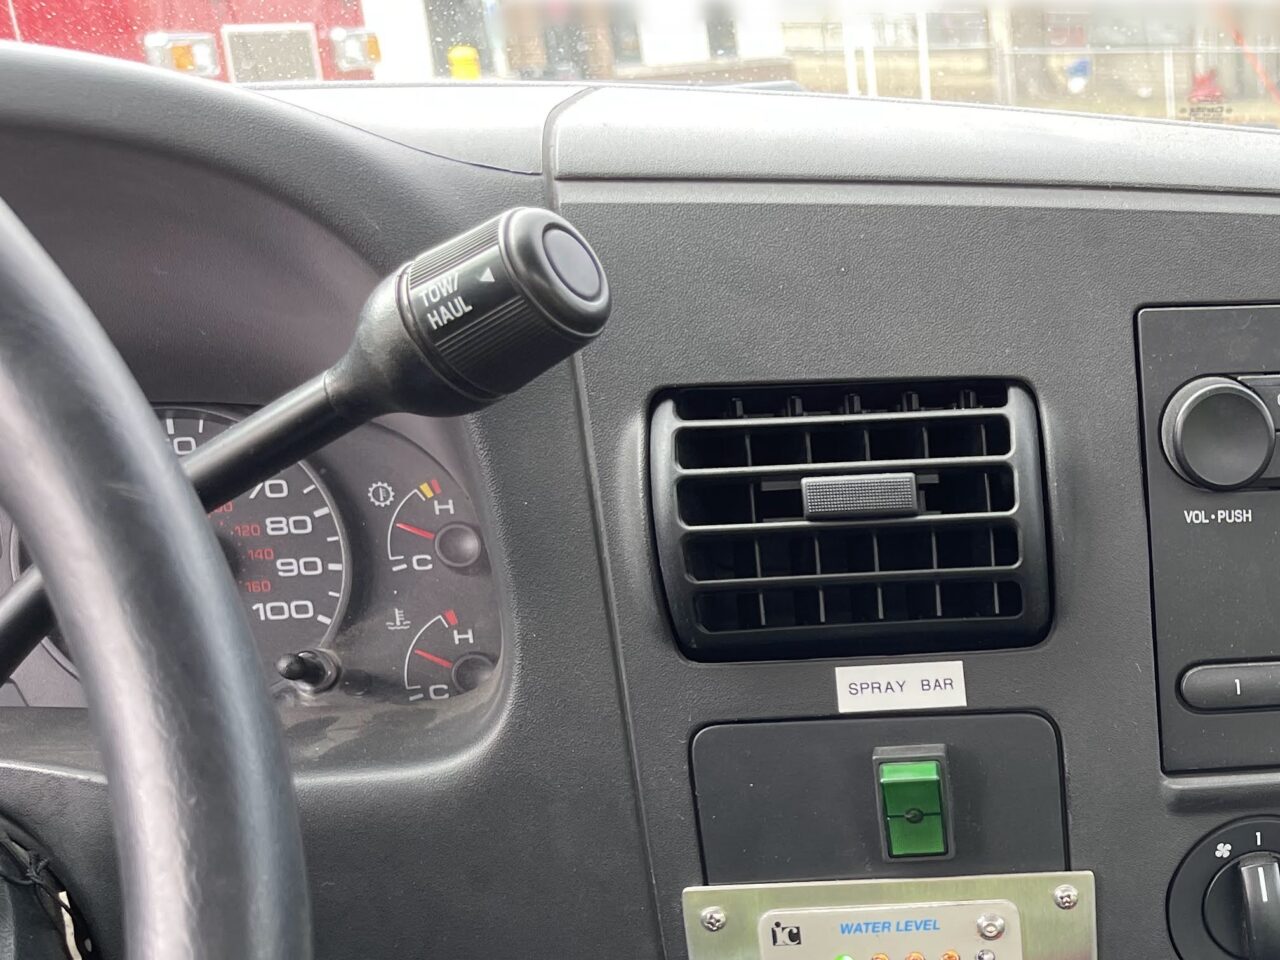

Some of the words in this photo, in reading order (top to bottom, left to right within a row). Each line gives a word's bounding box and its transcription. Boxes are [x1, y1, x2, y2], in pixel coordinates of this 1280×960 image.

[426, 295, 473, 330] HAUL
[433, 499, 455, 516] H
[234, 523, 261, 537] 120
[265, 516, 313, 536] 80
[248, 548, 275, 560] 140
[411, 554, 433, 571] C
[275, 556, 323, 577] 90
[245, 581, 271, 593] 160
[252, 600, 314, 621] 100
[453, 628, 474, 645] H
[429, 684, 450, 700] C
[848, 679, 907, 696] SPRAY
[921, 677, 955, 692] BAR
[1233, 678, 1242, 696] 1
[1254, 832, 1262, 846] 1
[840, 921, 892, 936] WATER
[896, 918, 941, 933] LEVEL
